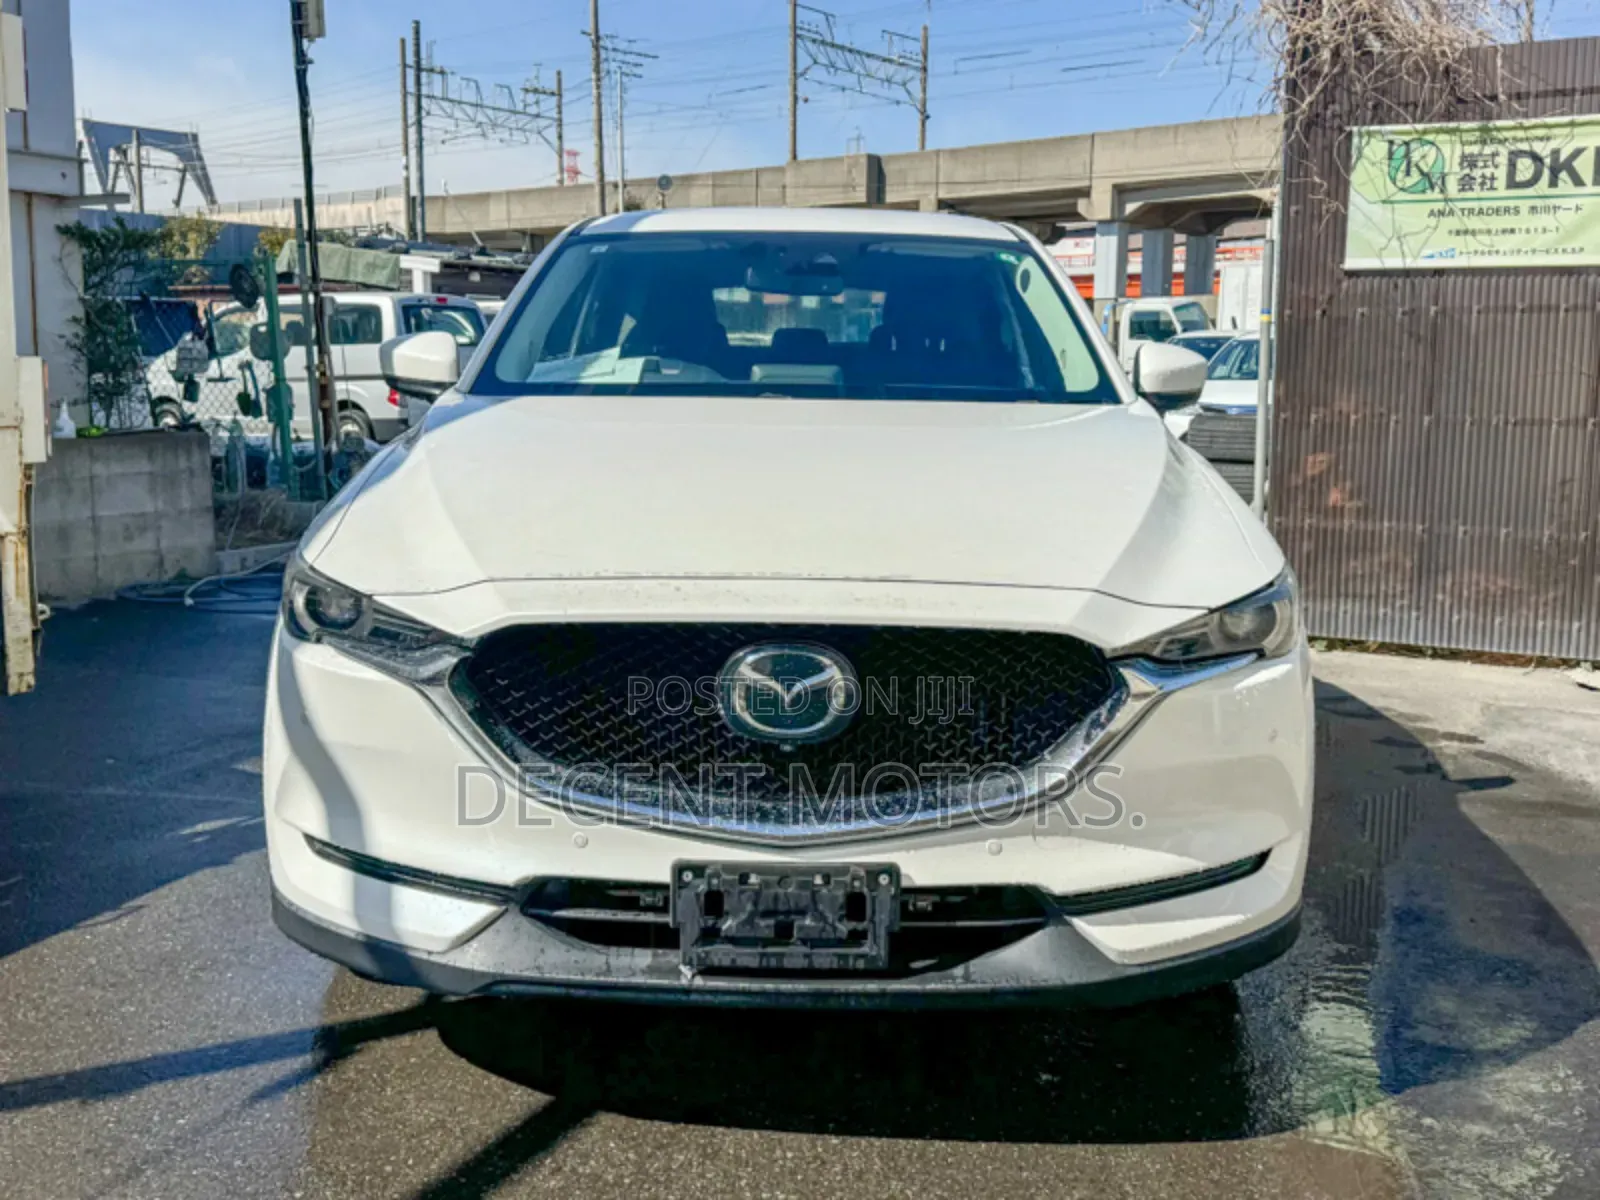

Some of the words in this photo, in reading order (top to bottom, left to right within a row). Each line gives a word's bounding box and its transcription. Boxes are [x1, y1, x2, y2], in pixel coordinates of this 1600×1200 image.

[1459, 151, 1500, 171] 株式
[1504, 145, 1600, 190] DK
[1457, 172, 1499, 193] 会社
[1427, 207, 1456, 219] ANA
[1460, 205, 1521, 217] TRADERS
